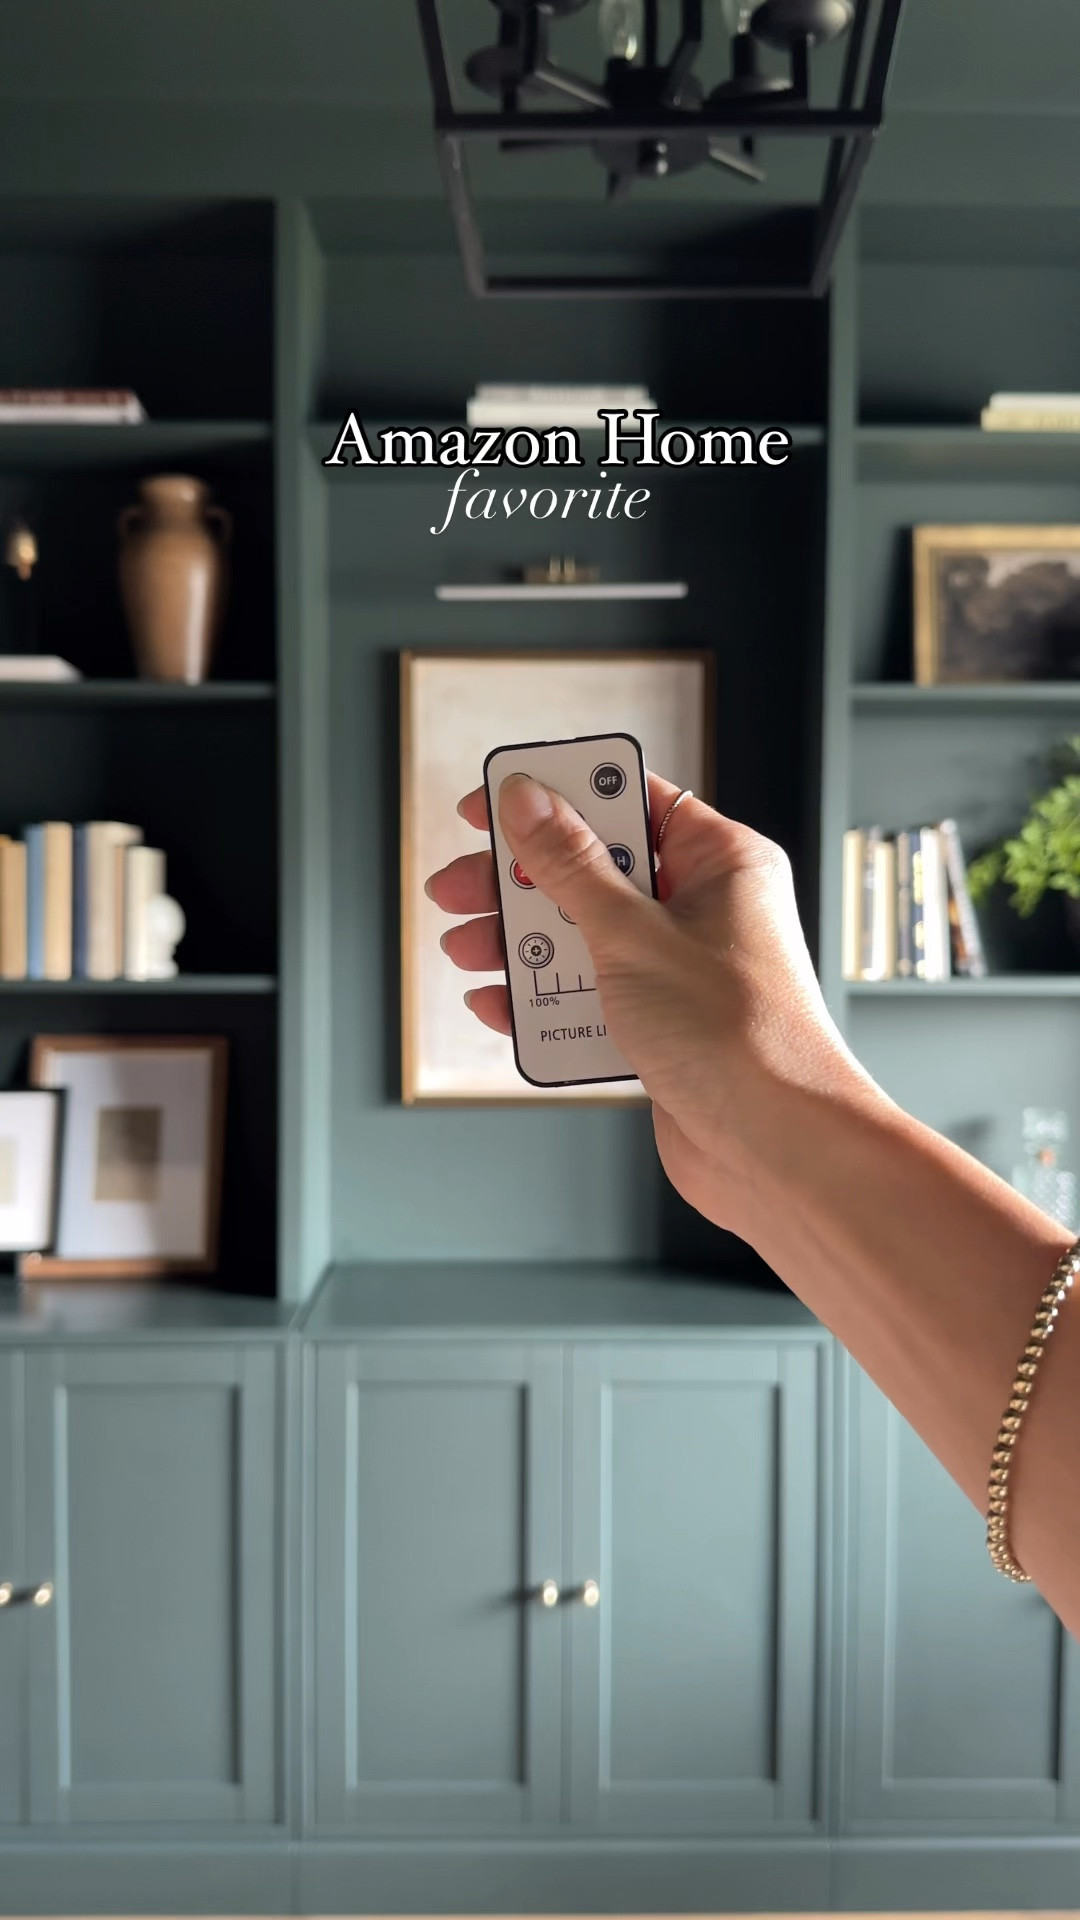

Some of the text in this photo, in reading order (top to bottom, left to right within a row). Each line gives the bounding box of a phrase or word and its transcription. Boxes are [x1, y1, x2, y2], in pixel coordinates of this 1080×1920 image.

[598, 775, 618, 787] OFF
[529, 996, 560, 1008] 100%
[540, 1024, 607, 1042] PICTURE LI
